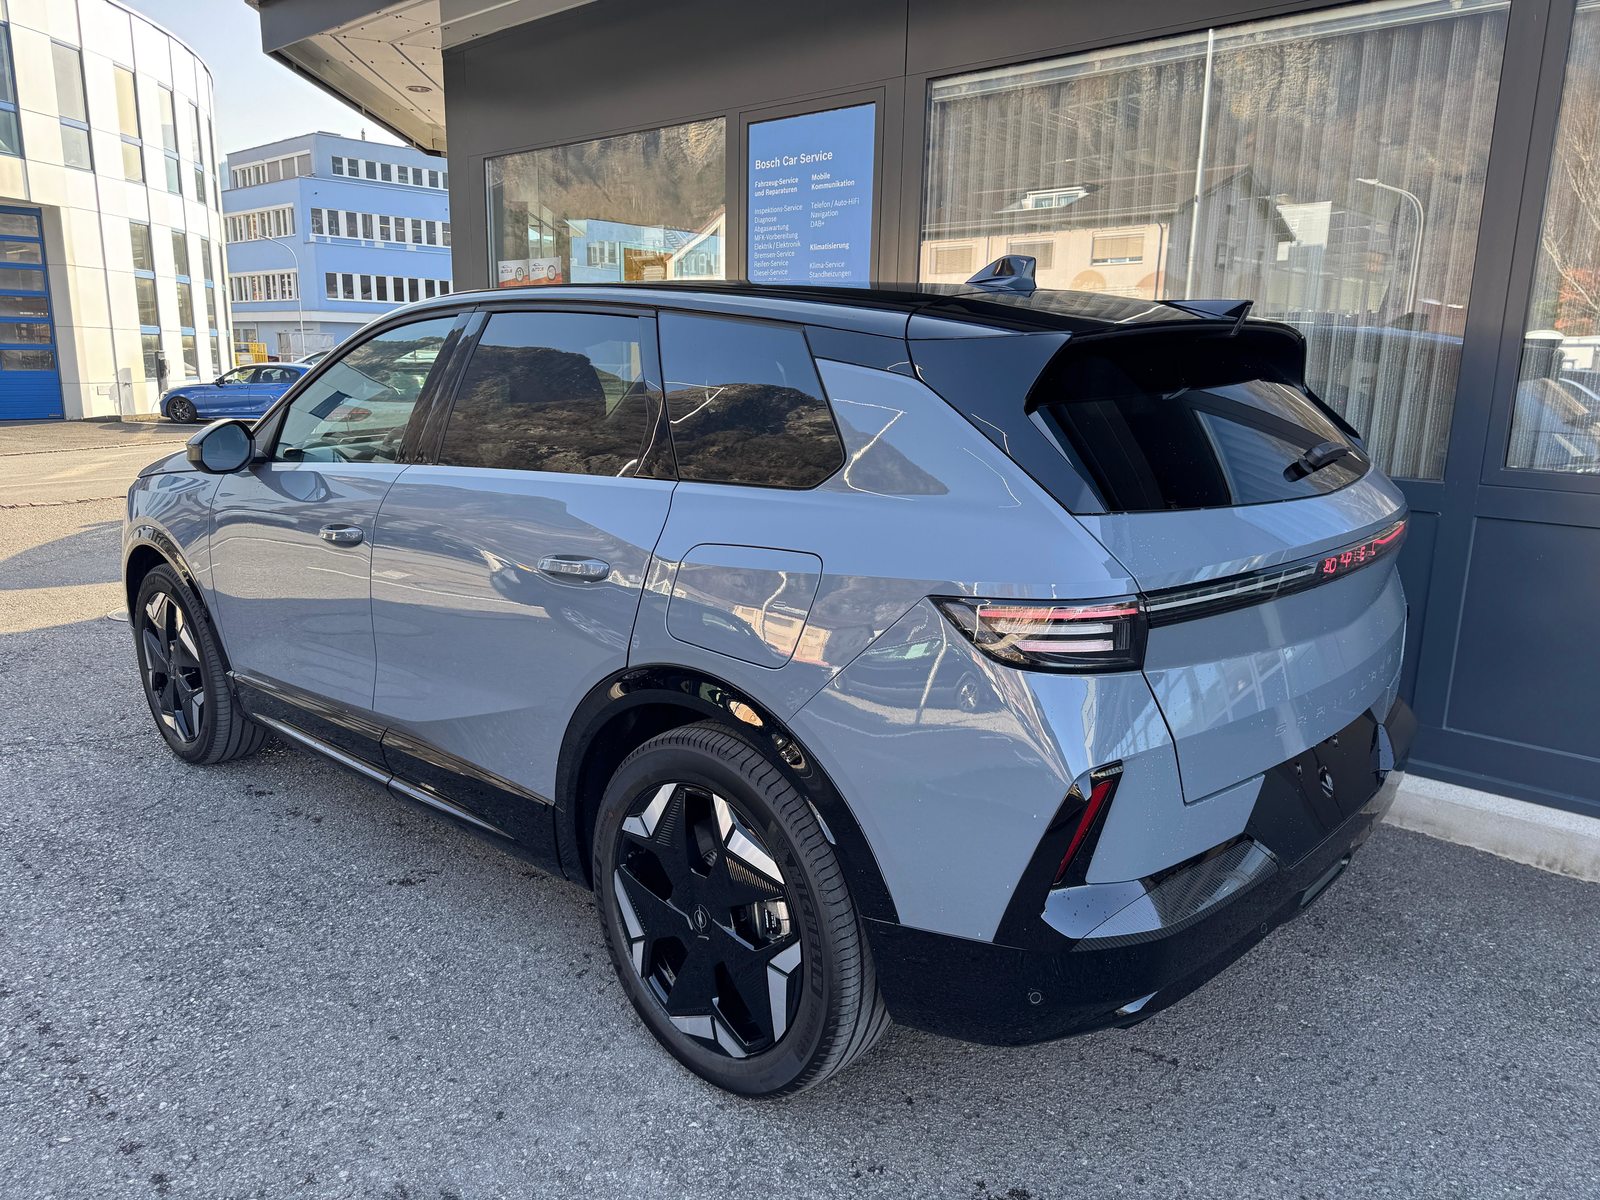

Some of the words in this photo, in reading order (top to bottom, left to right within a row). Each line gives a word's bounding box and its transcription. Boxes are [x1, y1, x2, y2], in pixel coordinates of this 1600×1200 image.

[755, 157, 780, 170] Bosch
[782, 155, 798, 167] Car
[800, 150, 833, 164] Service
[811, 172, 831, 181] Mobile
[754, 176, 799, 188] Fahrzeug-Service
[811, 179, 855, 190] Kommunikation
[754, 189, 764, 197] und
[765, 186, 798, 197] Reparaturen
[811, 200, 830, 209] Telefon
[754, 204, 803, 215] Inspektions-Service
[810, 210, 839, 219] Navigation
[754, 216, 777, 225] Diagnose
[810, 220, 825, 228] DAB+
[754, 224, 789, 233] Abgaswartung
[776, 240, 801, 249] Elektronik
[809, 242, 850, 251] Klimatisierung
[754, 250, 795, 259] Bremsen-Service
[809, 261, 845, 269] Klima-Service
[753, 268, 788, 277] Diesel-Service
[809, 270, 852, 279] Standheizungen
